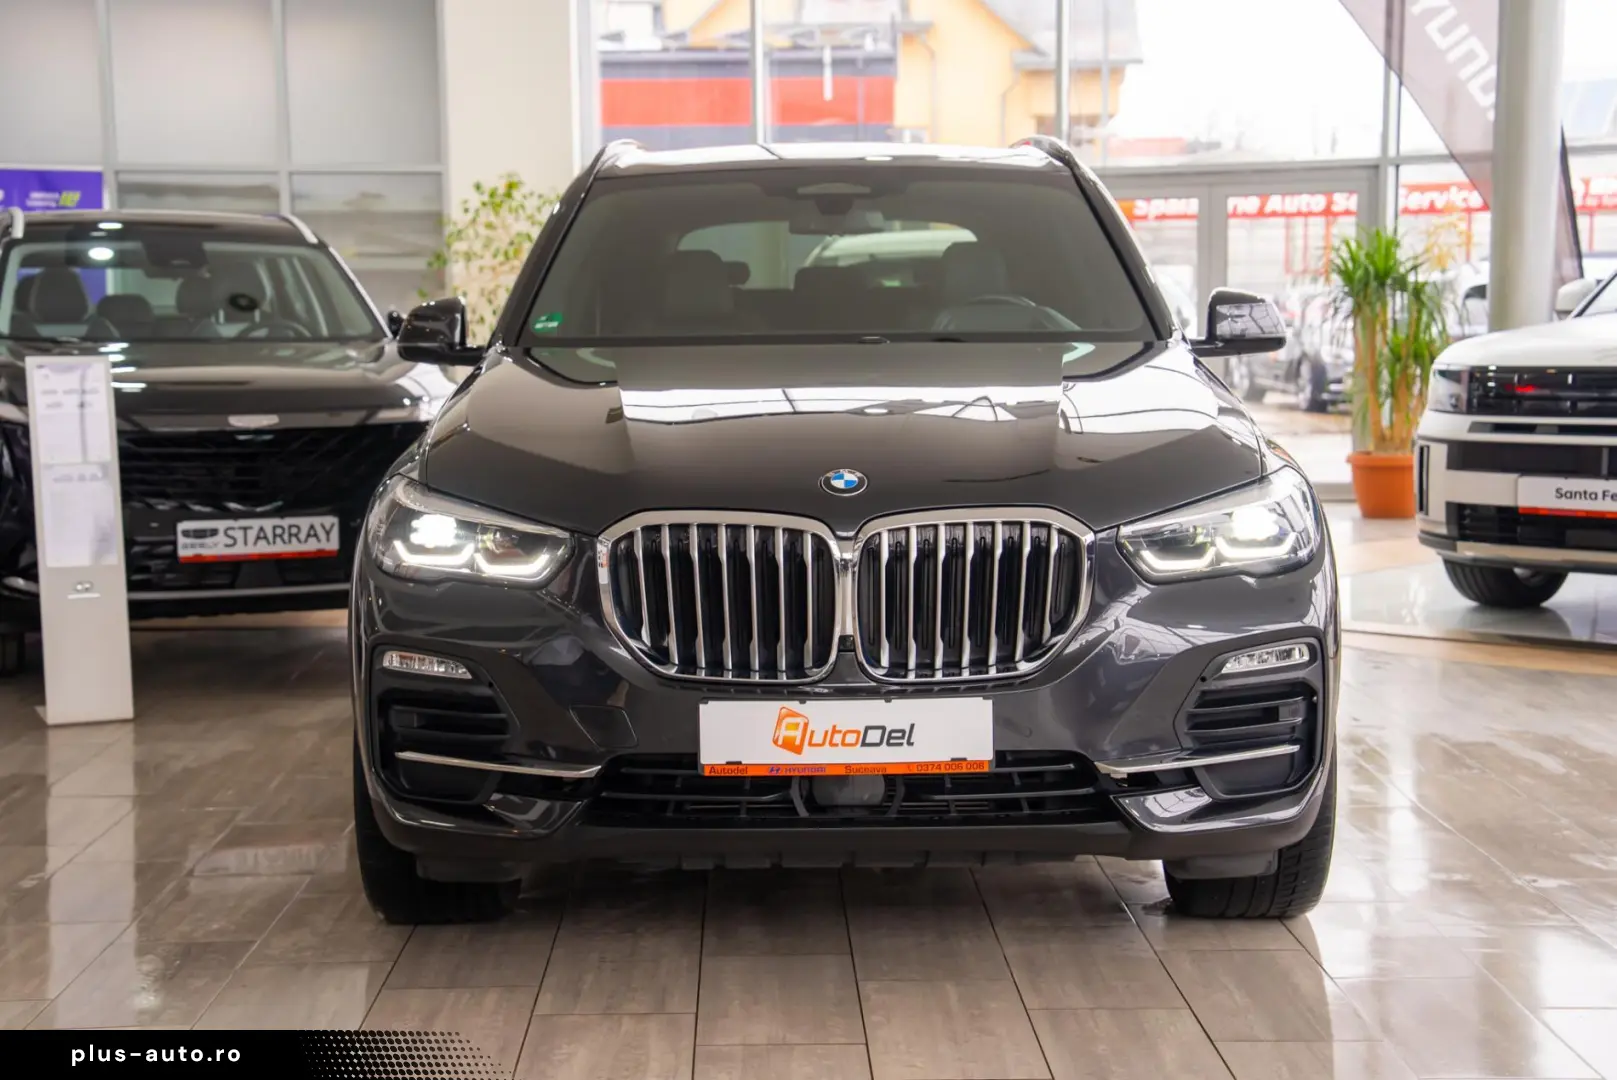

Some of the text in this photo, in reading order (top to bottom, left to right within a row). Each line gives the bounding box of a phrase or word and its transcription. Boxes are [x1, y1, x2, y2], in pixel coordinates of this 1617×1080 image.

[1264, 194, 1329, 212] Auto
[1555, 487, 1617, 502] Santa Fe
[223, 522, 336, 548] STARRAY
[774, 712, 915, 750] AutoDel
[709, 766, 748, 775] Autodel
[844, 765, 887, 774] Suceava
[916, 763, 941, 772] 0374
